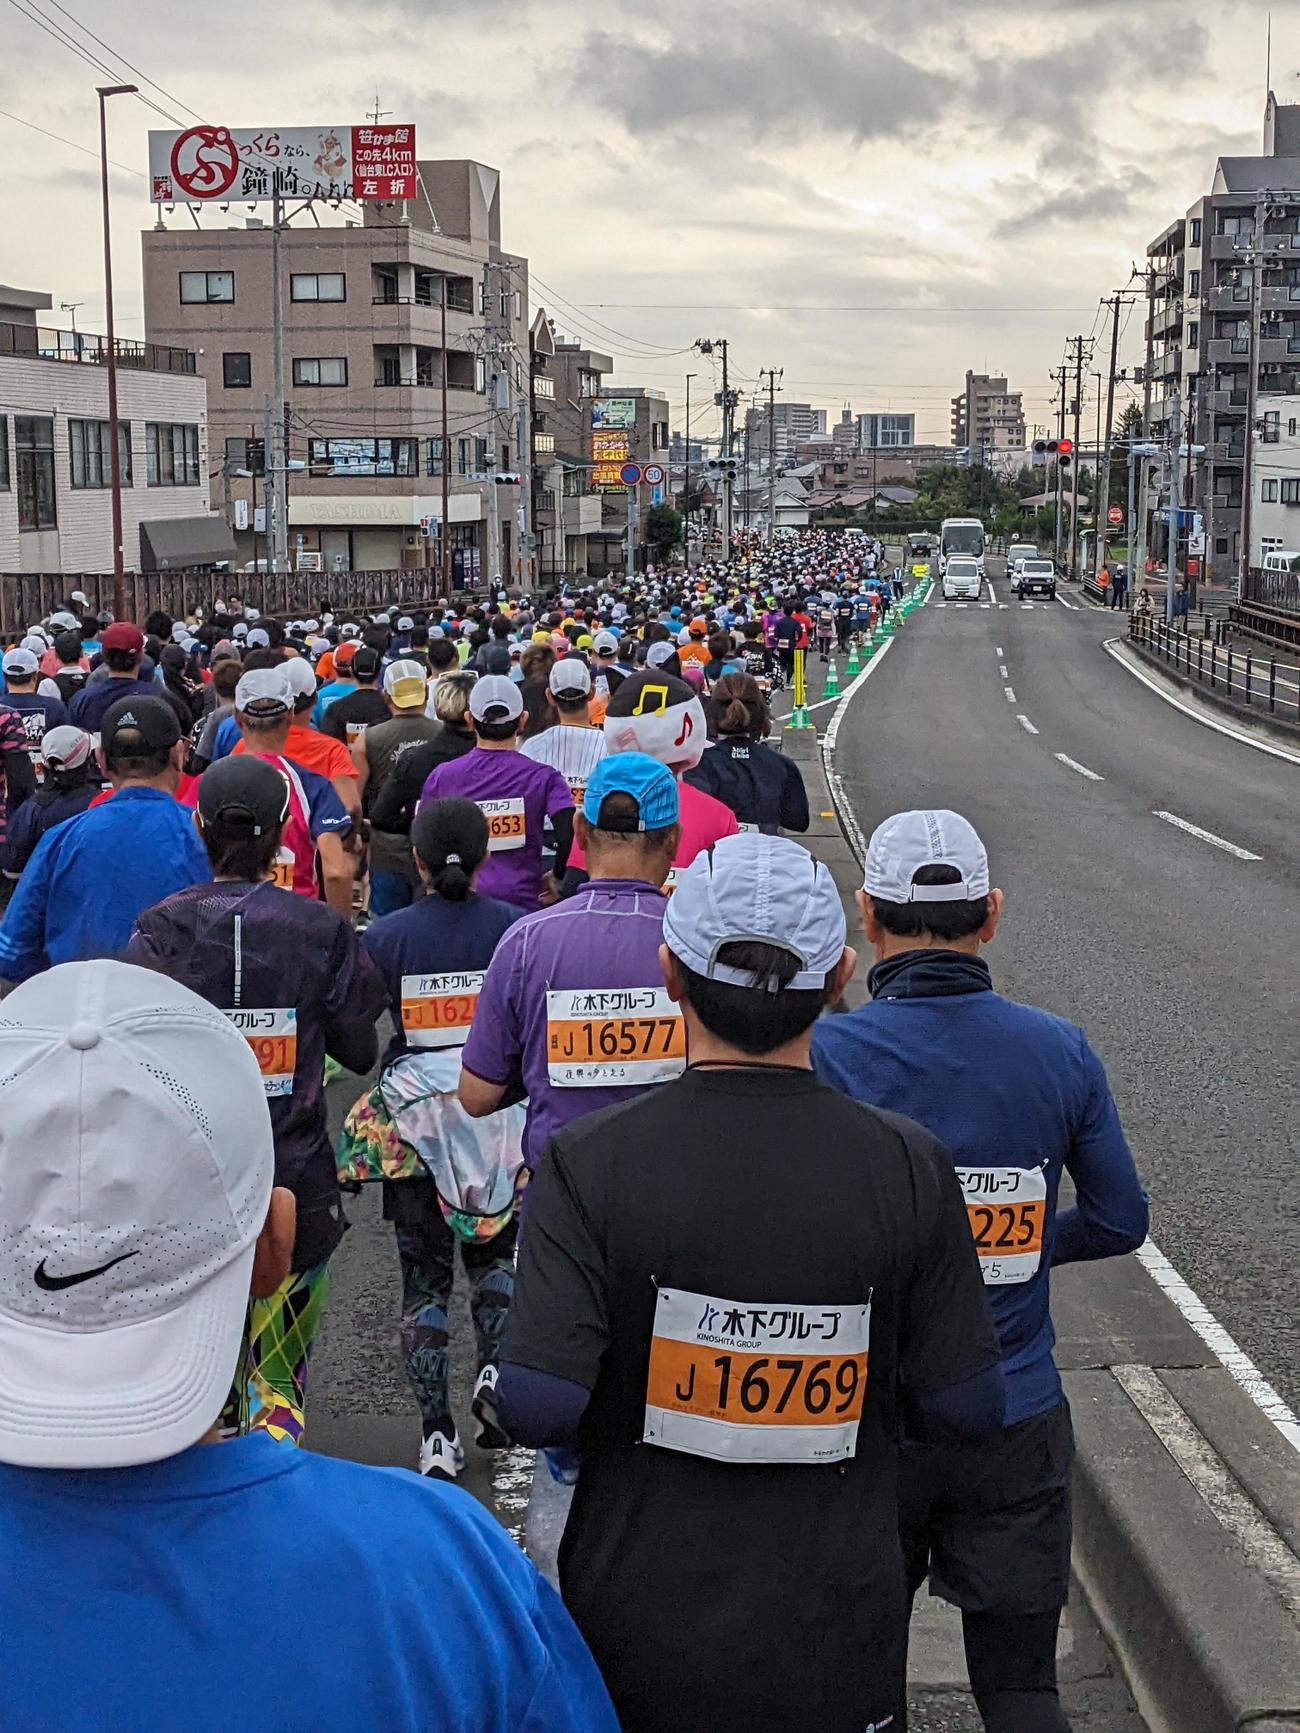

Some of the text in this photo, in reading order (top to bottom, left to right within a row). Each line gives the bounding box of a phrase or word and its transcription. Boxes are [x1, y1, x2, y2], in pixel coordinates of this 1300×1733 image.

[355, 147, 412, 161] この先4km
[647, 469, 660, 480] 50
[491, 816, 521, 835] 653
[430, 996, 480, 1023] 162
[583, 991, 657, 1011] 木下グループ
[563, 1032, 574, 1056] J
[582, 1019, 676, 1056] 16577
[247, 1038, 287, 1069] 91
[974, 1204, 1036, 1248] 225
[721, 1308, 841, 1340] 木下グループ
[696, 1332, 762, 1349] KINOSHITA GROUP
[675, 1355, 859, 1415] J 16769
